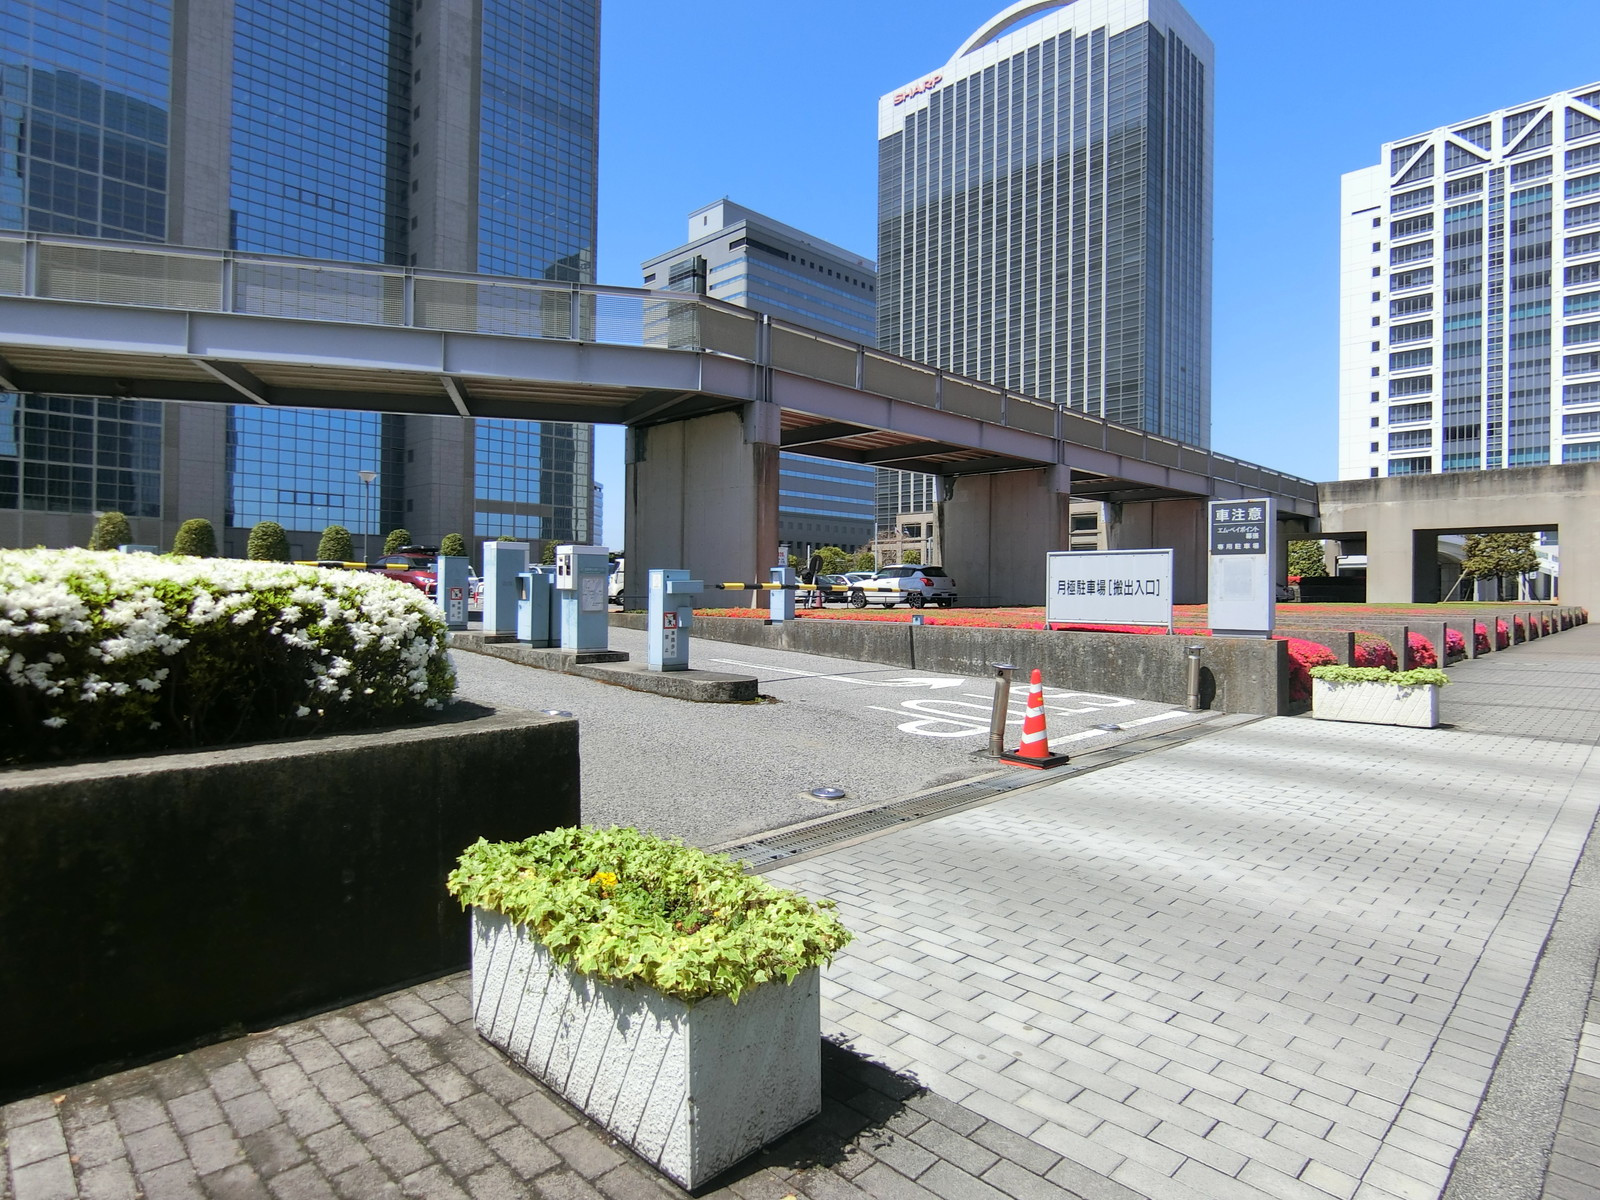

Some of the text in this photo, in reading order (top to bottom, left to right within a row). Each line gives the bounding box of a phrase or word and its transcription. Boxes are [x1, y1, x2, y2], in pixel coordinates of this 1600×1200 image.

[893, 74, 943, 106] SHARP
[1215, 507, 1262, 522] 車注意
